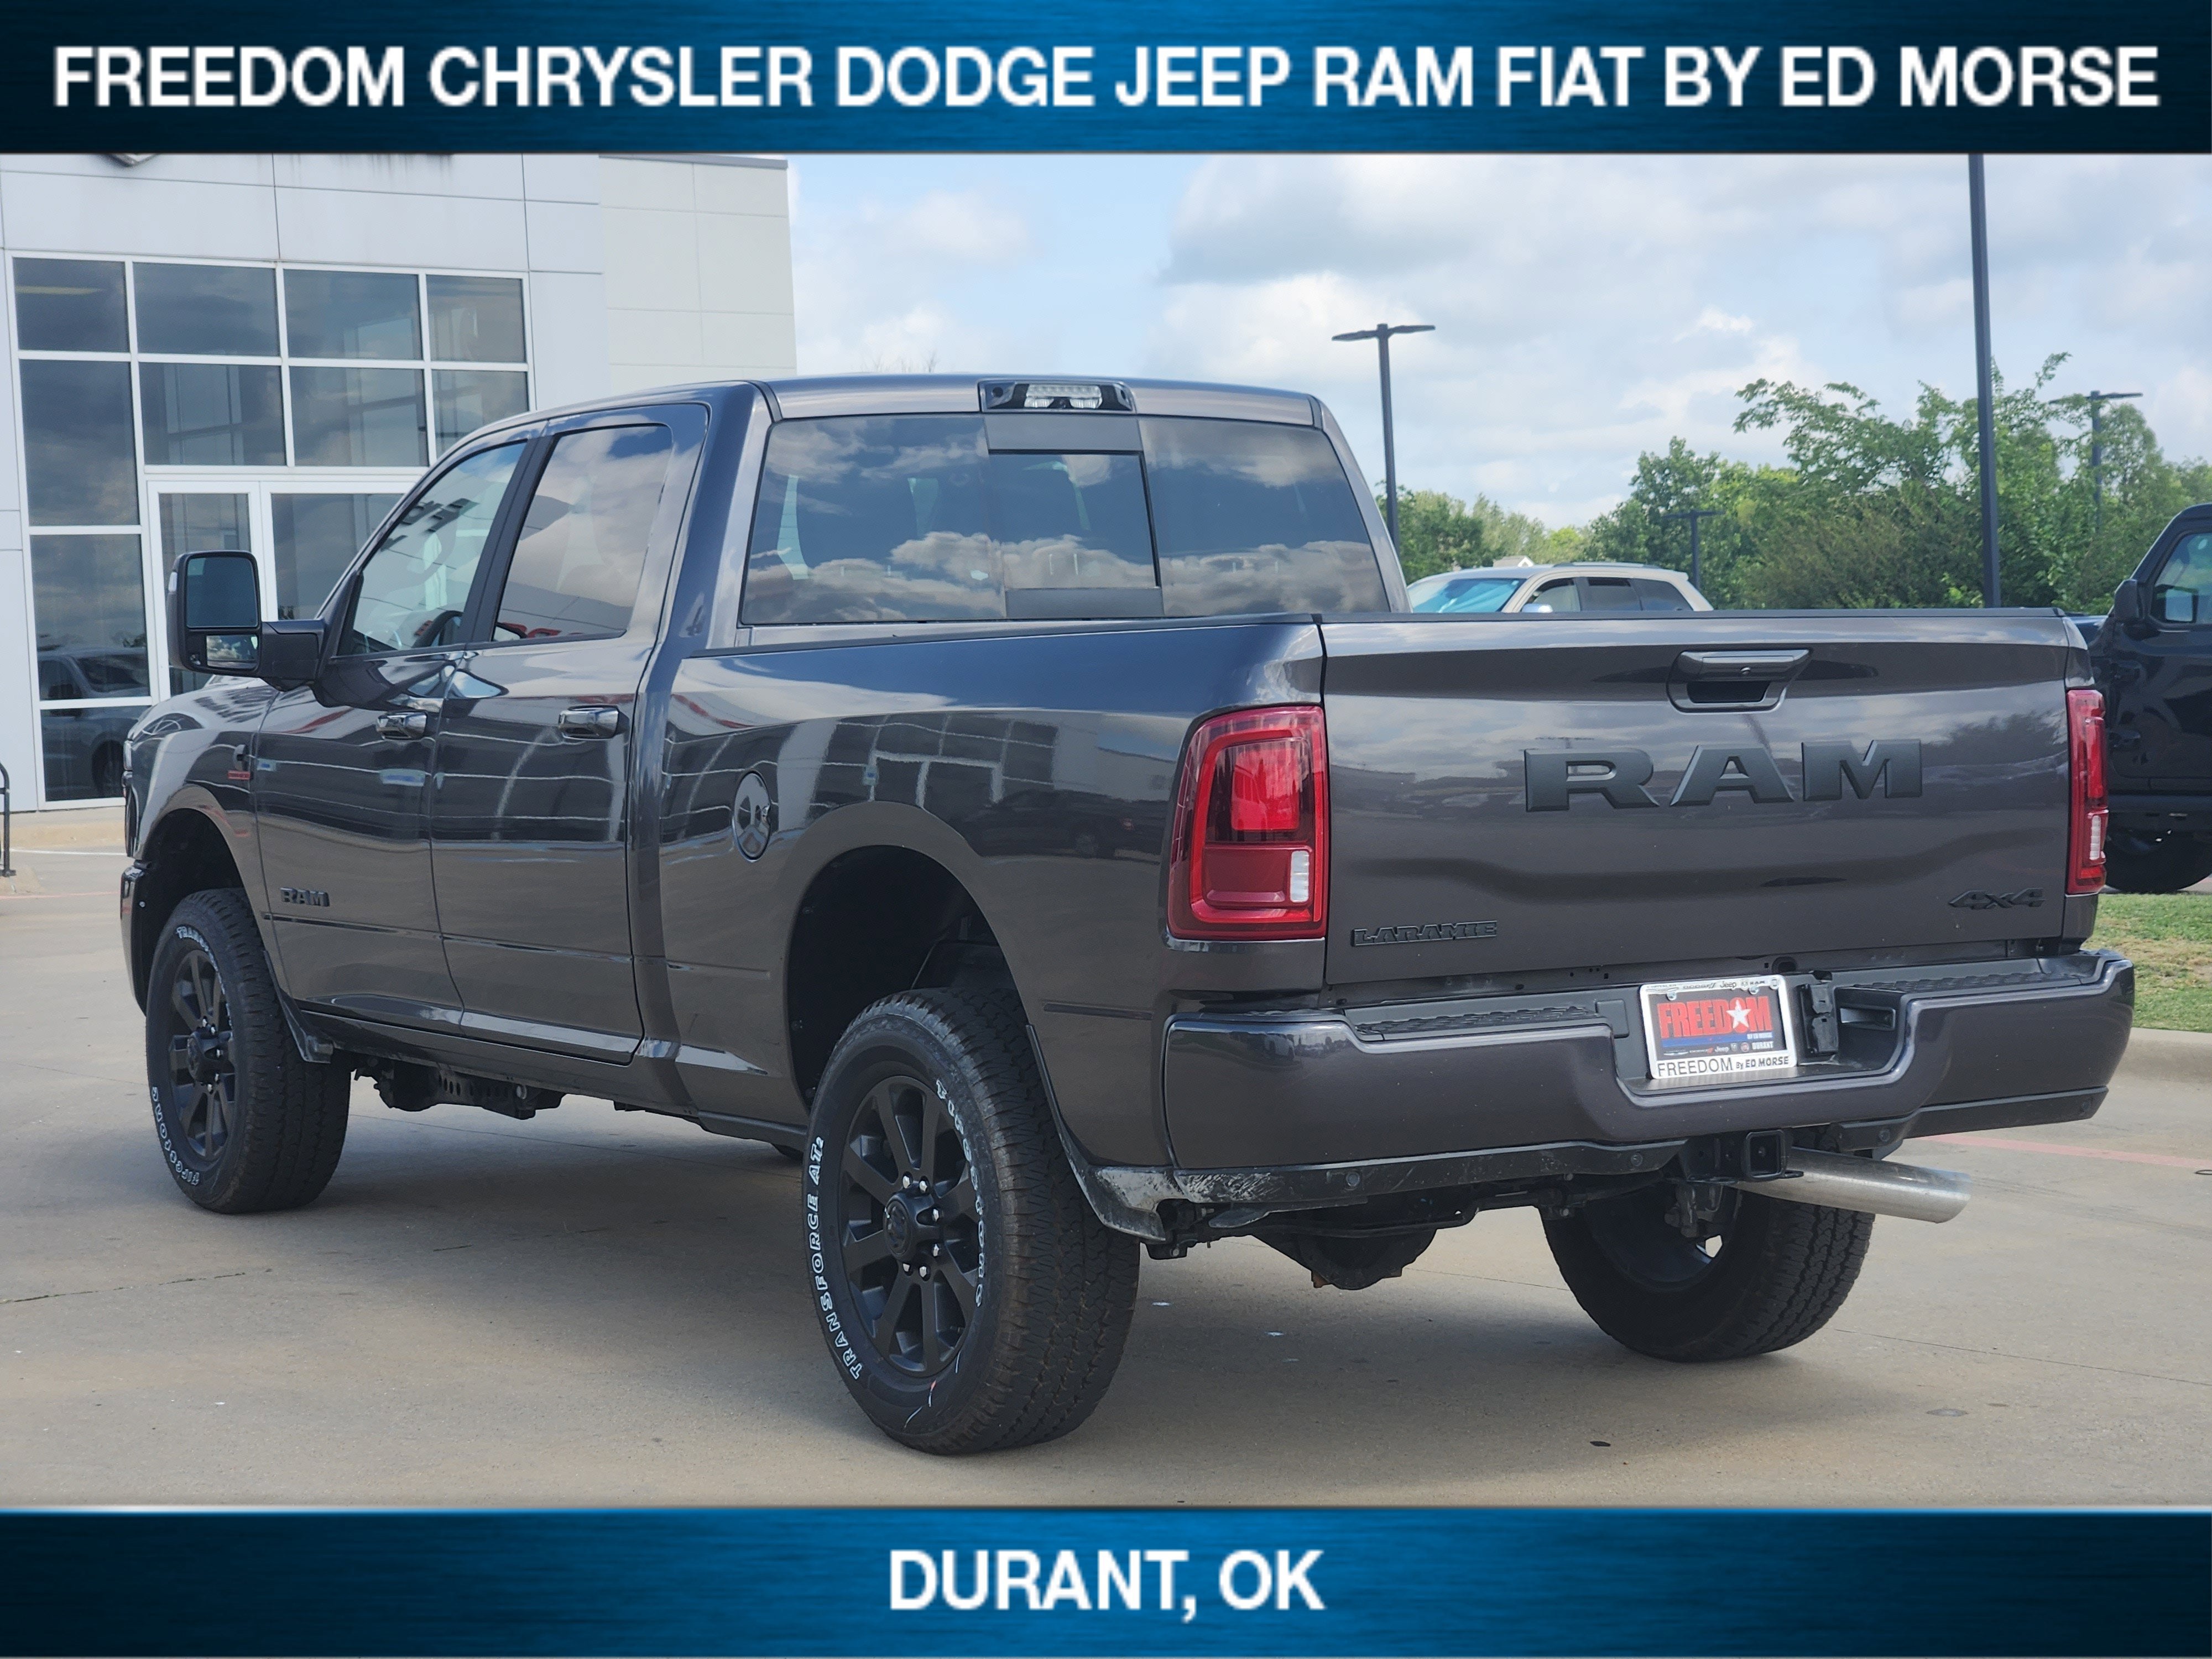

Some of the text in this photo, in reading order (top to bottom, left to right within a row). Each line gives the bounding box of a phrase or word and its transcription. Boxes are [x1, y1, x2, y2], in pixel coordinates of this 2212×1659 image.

[1524, 739, 1923, 812] RAM
[281, 887, 330, 907] RAM
[1351, 920, 1498, 947] LARAMIE
[1657, 996, 1772, 1038] FREEDOM
[1657, 1057, 1733, 1077] FREEDOM
[1745, 1058, 1756, 1068] ED
[1759, 1056, 1790, 1067] MORSE
[807, 1193, 863, 1380] TRANSFORCE
